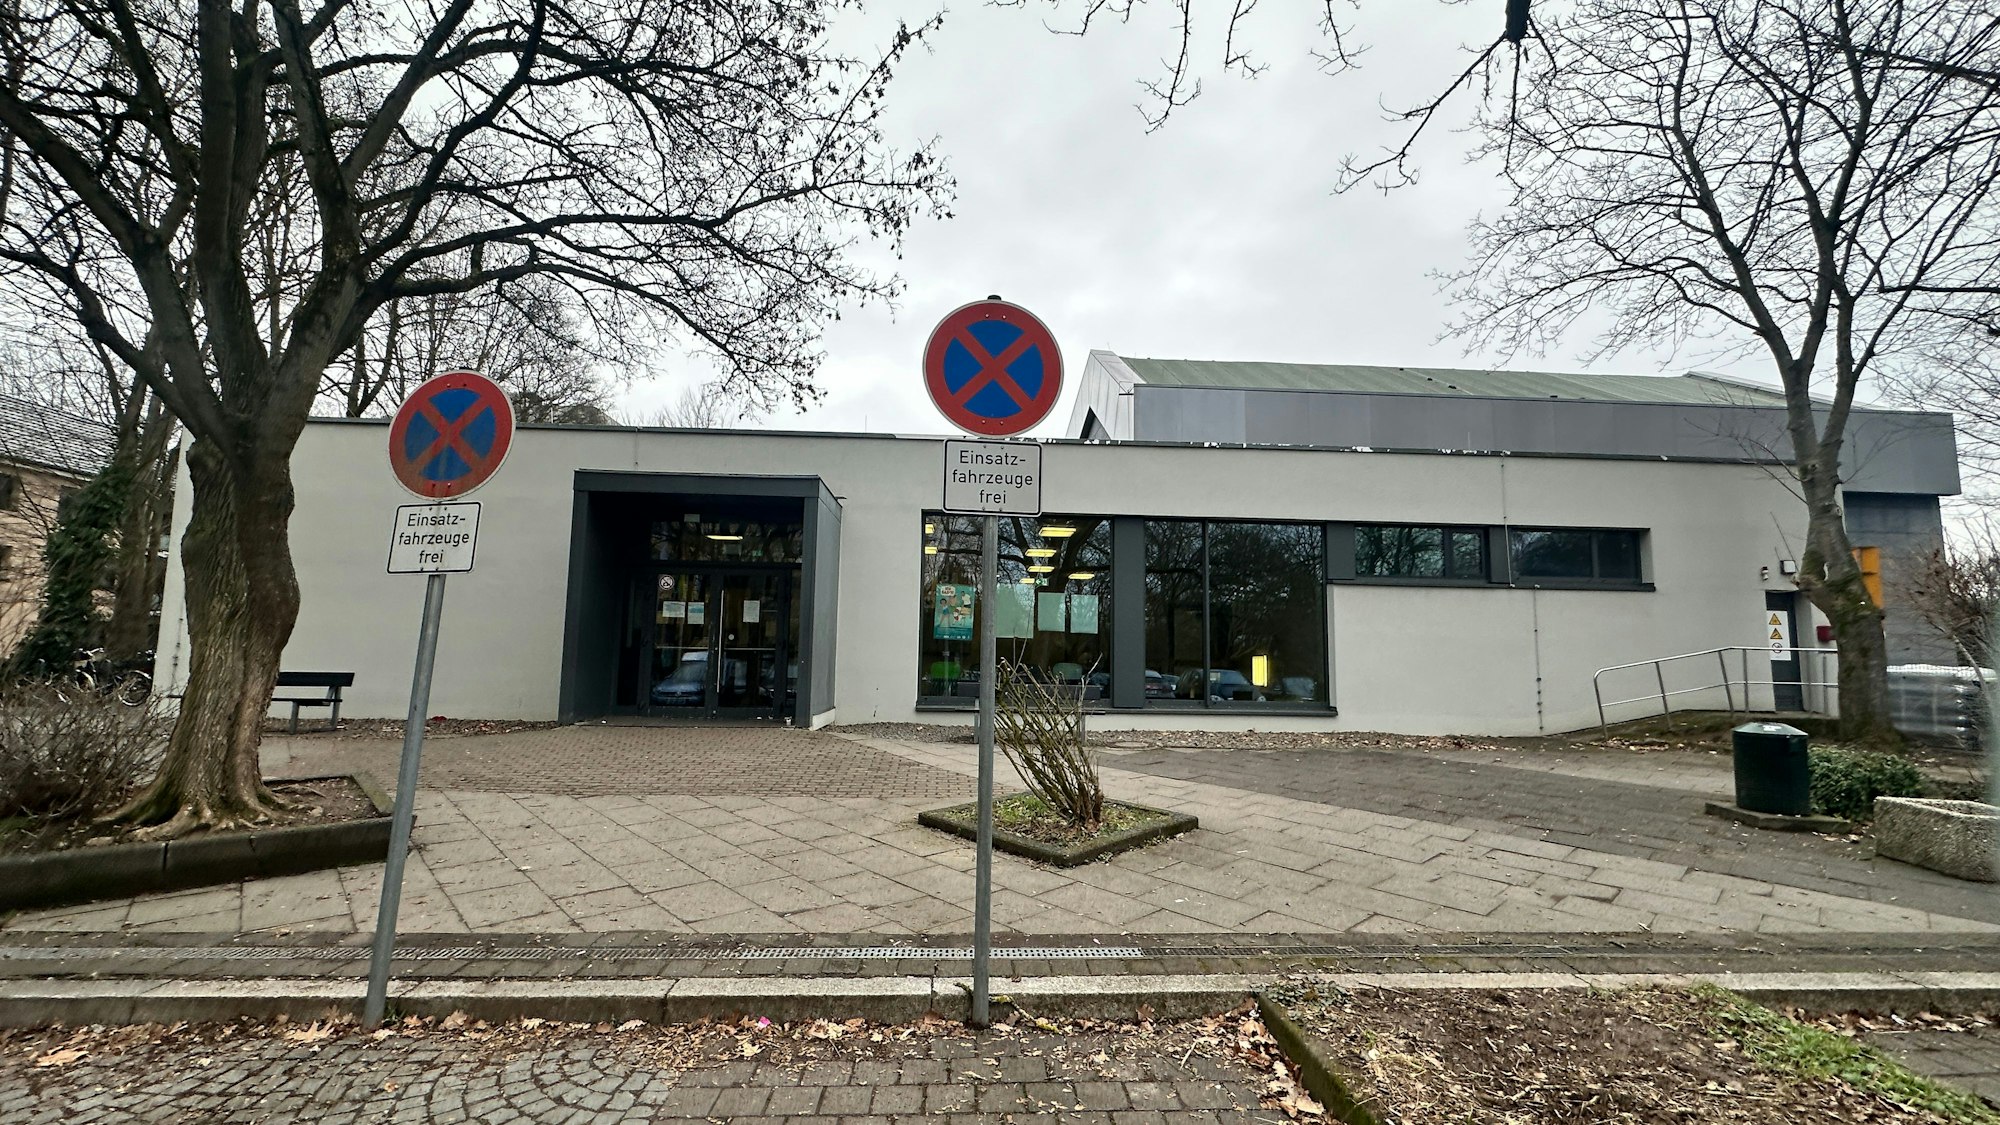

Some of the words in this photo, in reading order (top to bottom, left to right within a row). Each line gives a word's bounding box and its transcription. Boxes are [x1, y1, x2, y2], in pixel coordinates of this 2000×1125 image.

[960, 450, 1026, 466] Einsatz-
[952, 469, 1033, 489] fahrzeuge
[979, 489, 1007, 504] frei
[407, 513, 466, 527] Einsatz-
[399, 531, 470, 547] fahrzeuge
[419, 549, 444, 564] frei
